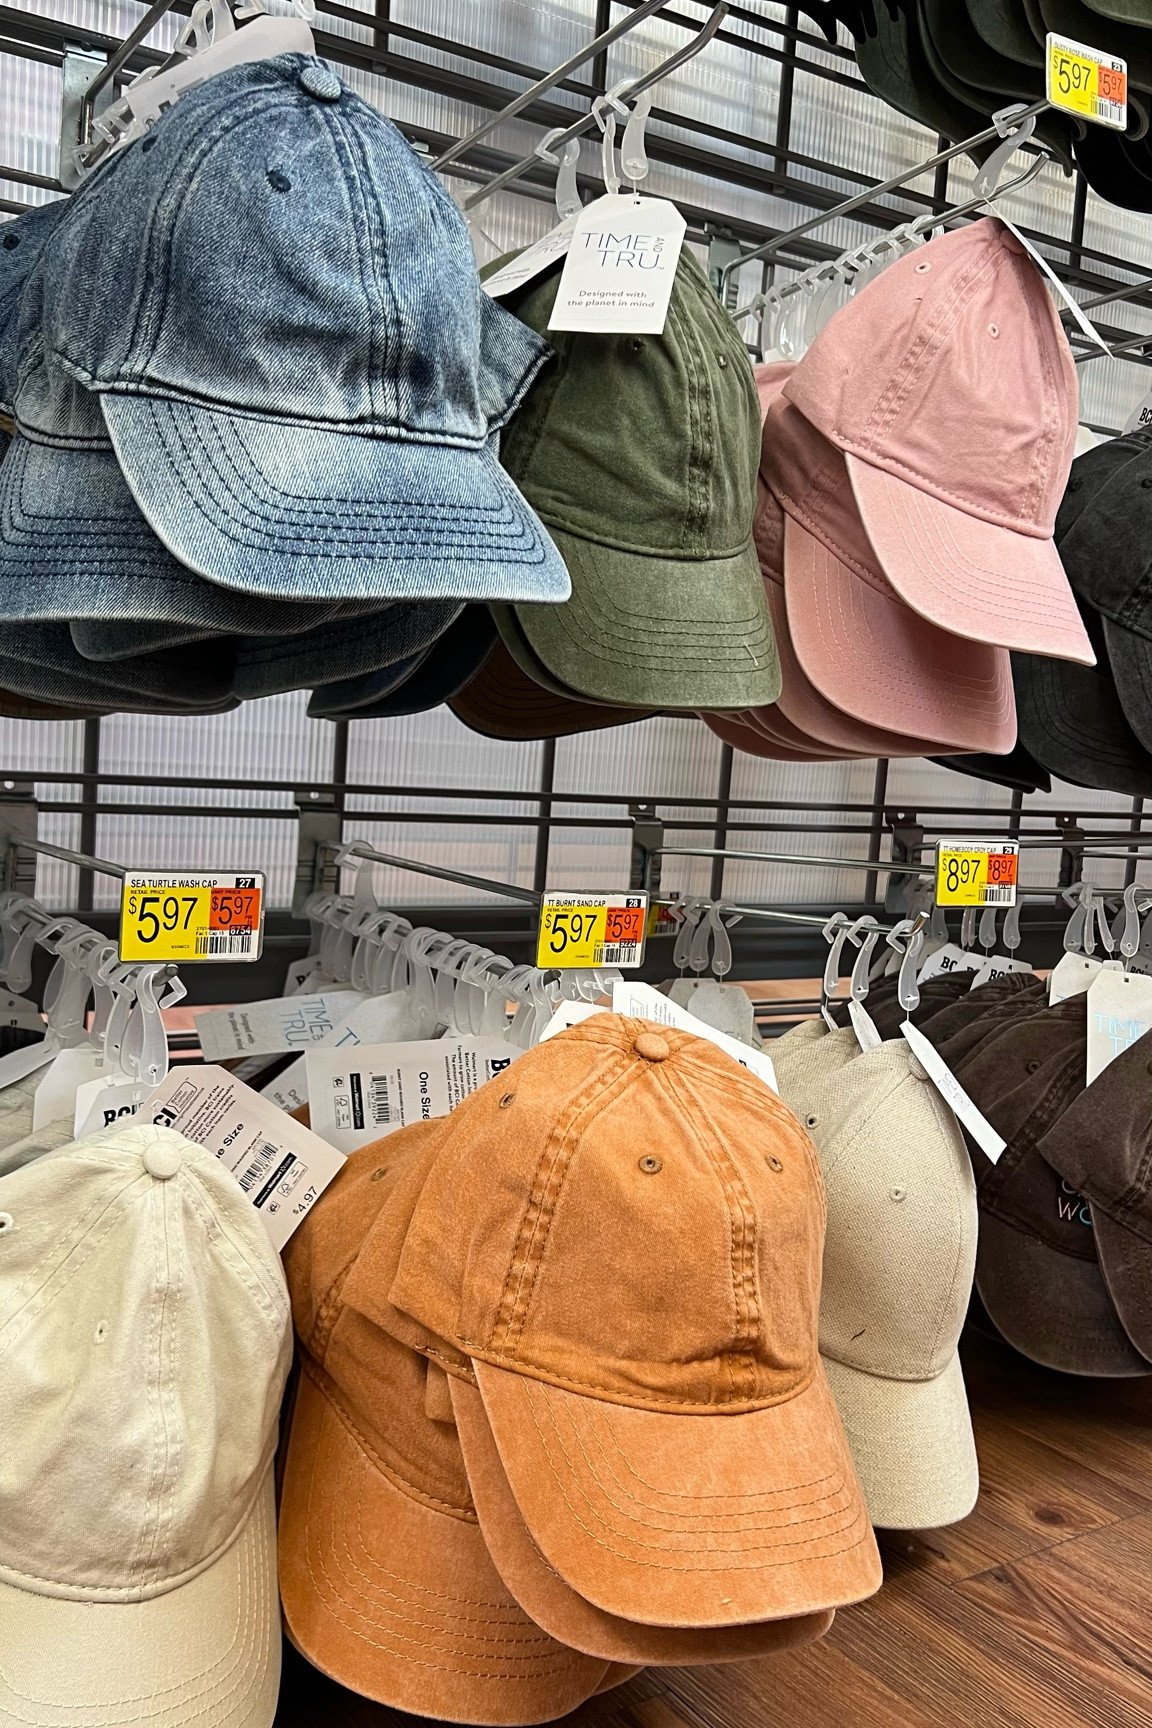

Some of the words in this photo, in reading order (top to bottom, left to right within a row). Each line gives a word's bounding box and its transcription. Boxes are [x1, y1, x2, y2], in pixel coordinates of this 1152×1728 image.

[1082, 52, 1094, 62] WASH
[581, 232, 652, 251] TIME
[653, 237, 665, 253] AND
[597, 250, 660, 270] TRU
[579, 290, 624, 299] Designed
[586, 300, 616, 309] planet
[131, 880, 145, 888] SEA
[148, 880, 177, 888] TURTLE
[179, 880, 200, 888] WASH
[202, 880, 218, 888] CAP
[239, 879, 251, 888] 27
[628, 899, 638, 907] 28
[301, 998, 333, 1037] TIME
[419, 1071, 429, 1093] One
[174, 1089, 188, 1106] Cotton
[204, 1100, 214, 1111] BCI
[212, 1086, 225, 1101] trains
[421, 1097, 431, 1119] Size
[150, 1105, 177, 1132] CI
[178, 1118, 193, 1134] proud
[190, 1098, 208, 1119] member
[211, 1084, 220, 1093] the
[197, 1126, 207, 1137] BCI
[204, 1109, 220, 1127] Cotton
[218, 1093, 233, 1110] credits
[189, 1122, 204, 1138] cotton
[202, 1109, 214, 1122] more
[204, 1123, 215, 1136] each
[213, 1112, 224, 1125] item
[222, 1121, 245, 1147] Size
[266, 1170, 283, 1189] Walmart
[291, 1185, 320, 1218] $4.97
